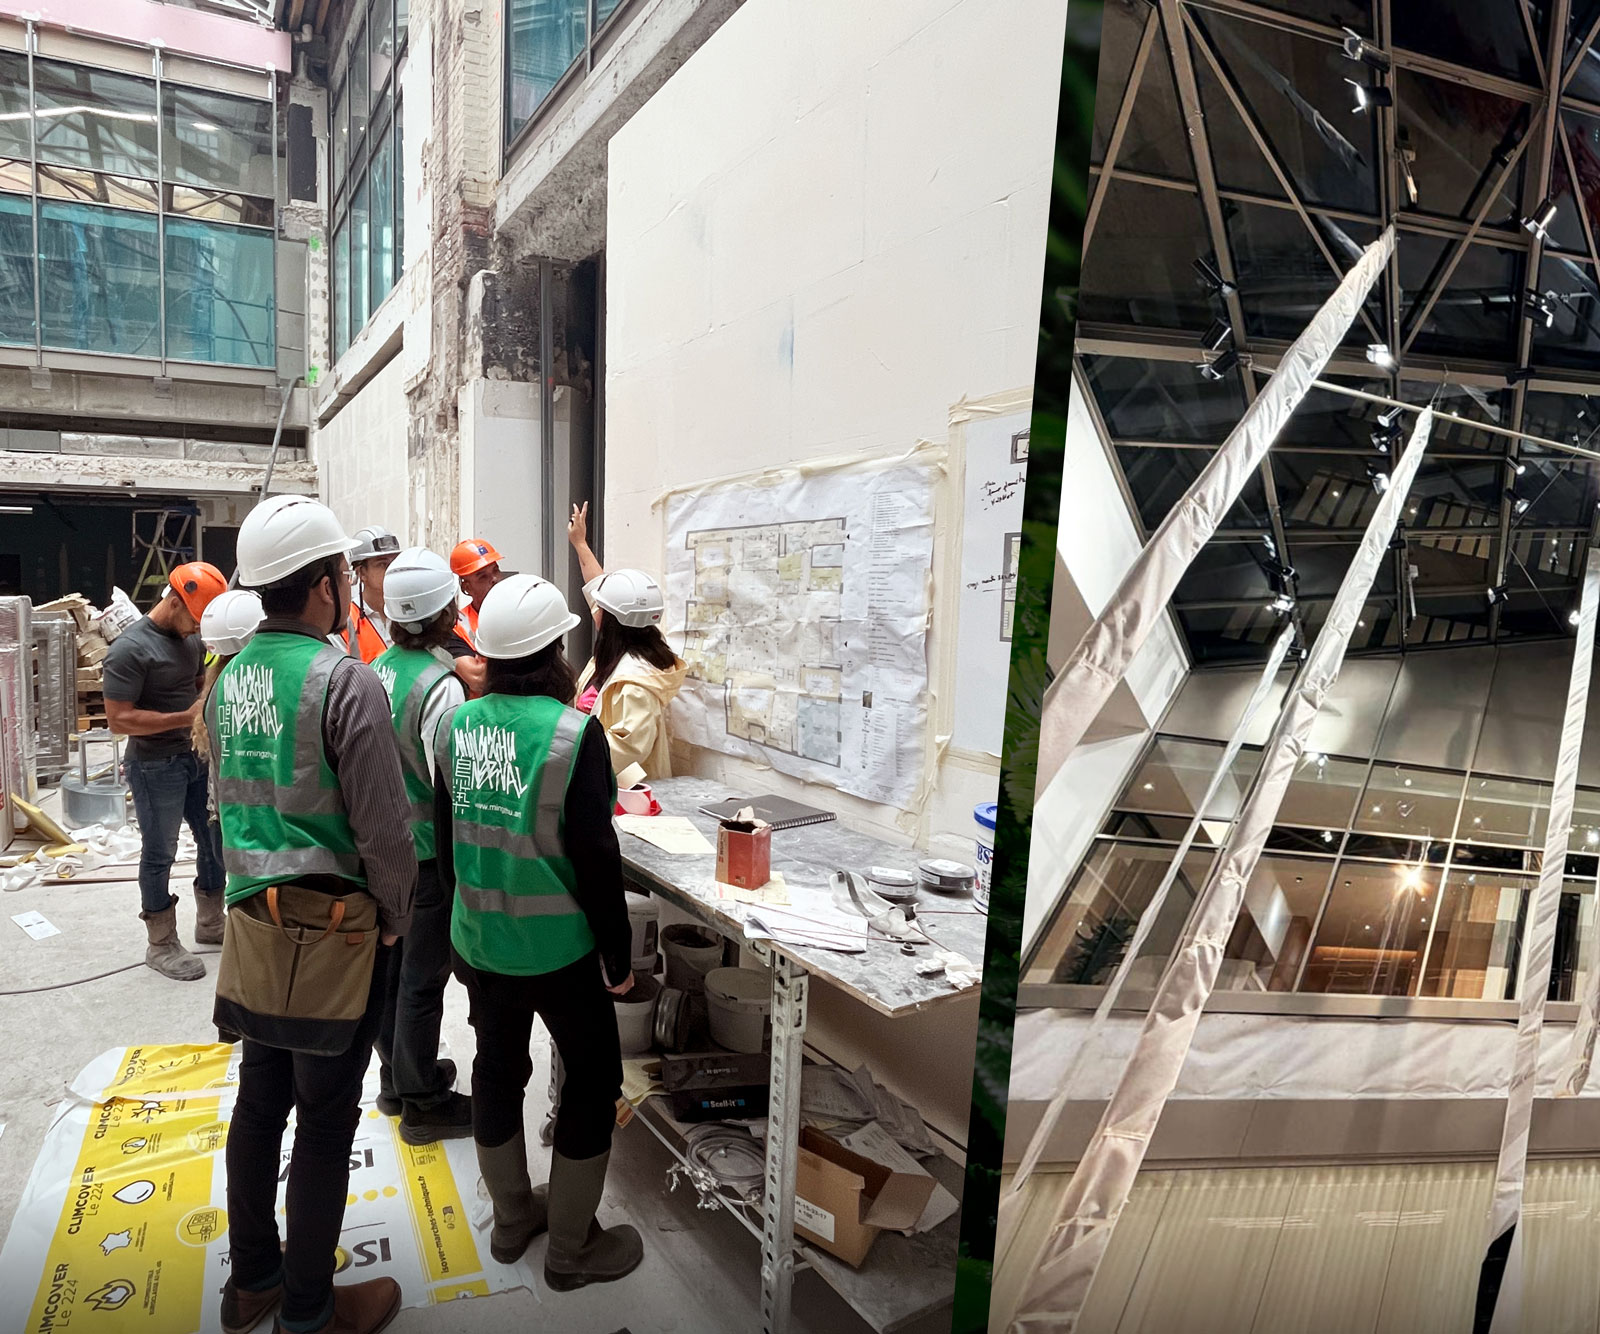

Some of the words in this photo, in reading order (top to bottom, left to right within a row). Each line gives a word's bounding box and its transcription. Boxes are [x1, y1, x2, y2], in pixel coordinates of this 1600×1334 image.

[67, 1166, 96, 1235] CLIMCOVER
[91, 1182, 104, 1201] 224
[86, 1203, 99, 1216] Le
[38, 1263, 69, 1334] IMCOVER
[61, 1279, 79, 1305] 224
[55, 1310, 71, 1327] Le
